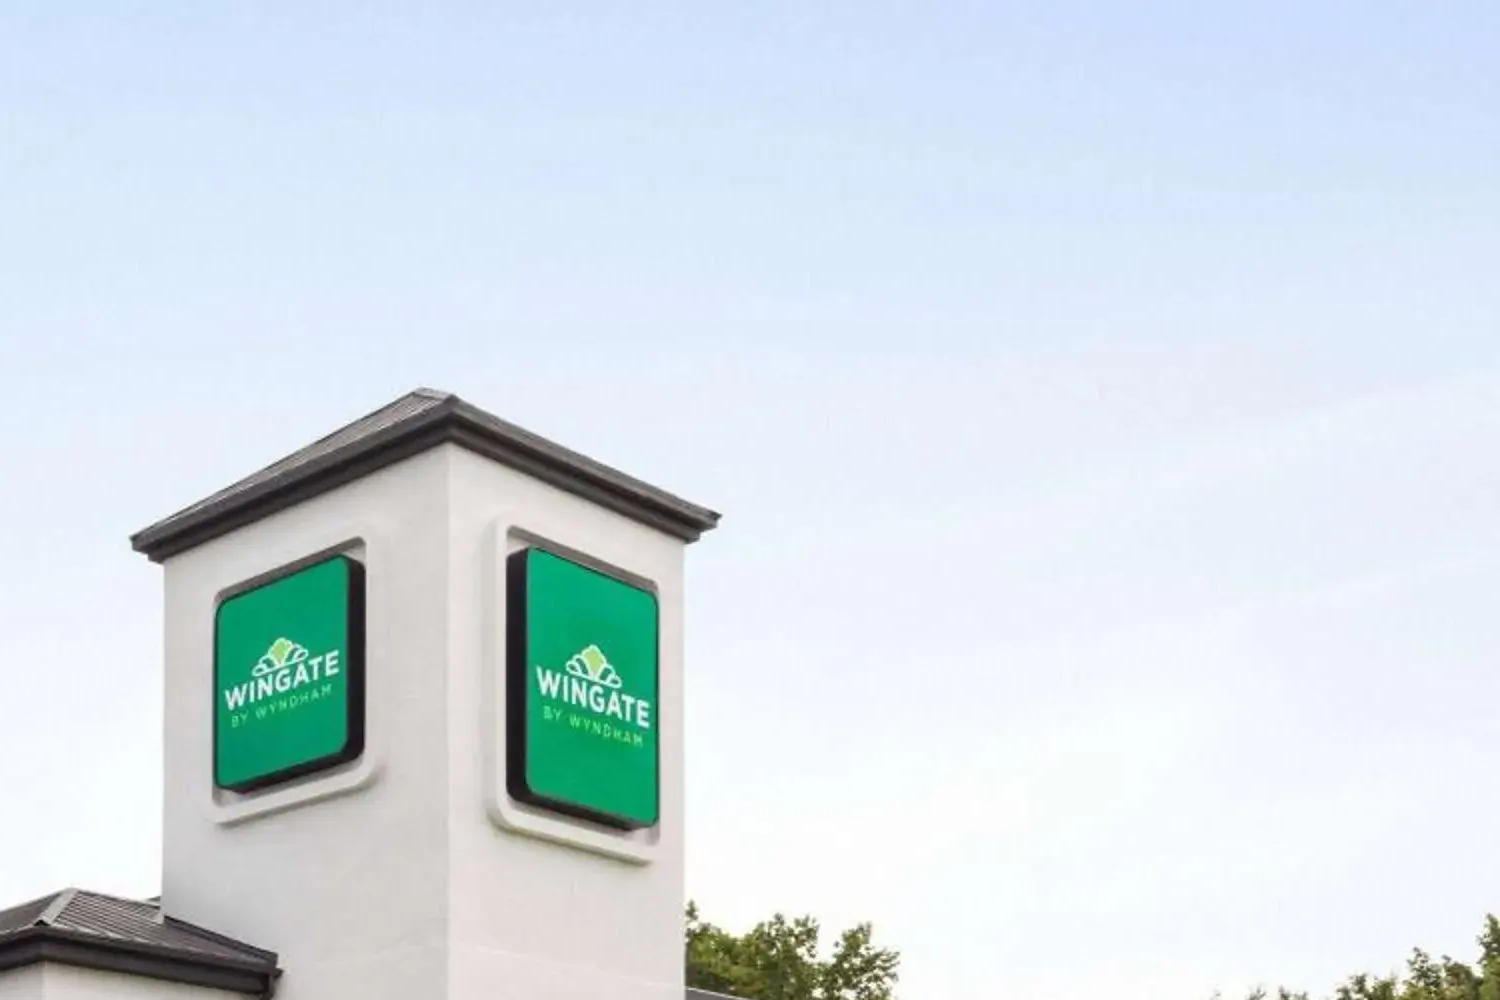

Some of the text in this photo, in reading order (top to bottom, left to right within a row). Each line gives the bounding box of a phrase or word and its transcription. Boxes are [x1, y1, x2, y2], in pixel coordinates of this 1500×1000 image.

[224, 649, 340, 711] WINGATE
[231, 683, 332, 728] BY WYNDHAM
[536, 664, 650, 729] WINGATE
[543, 705, 644, 747] BY WYNDHAM
